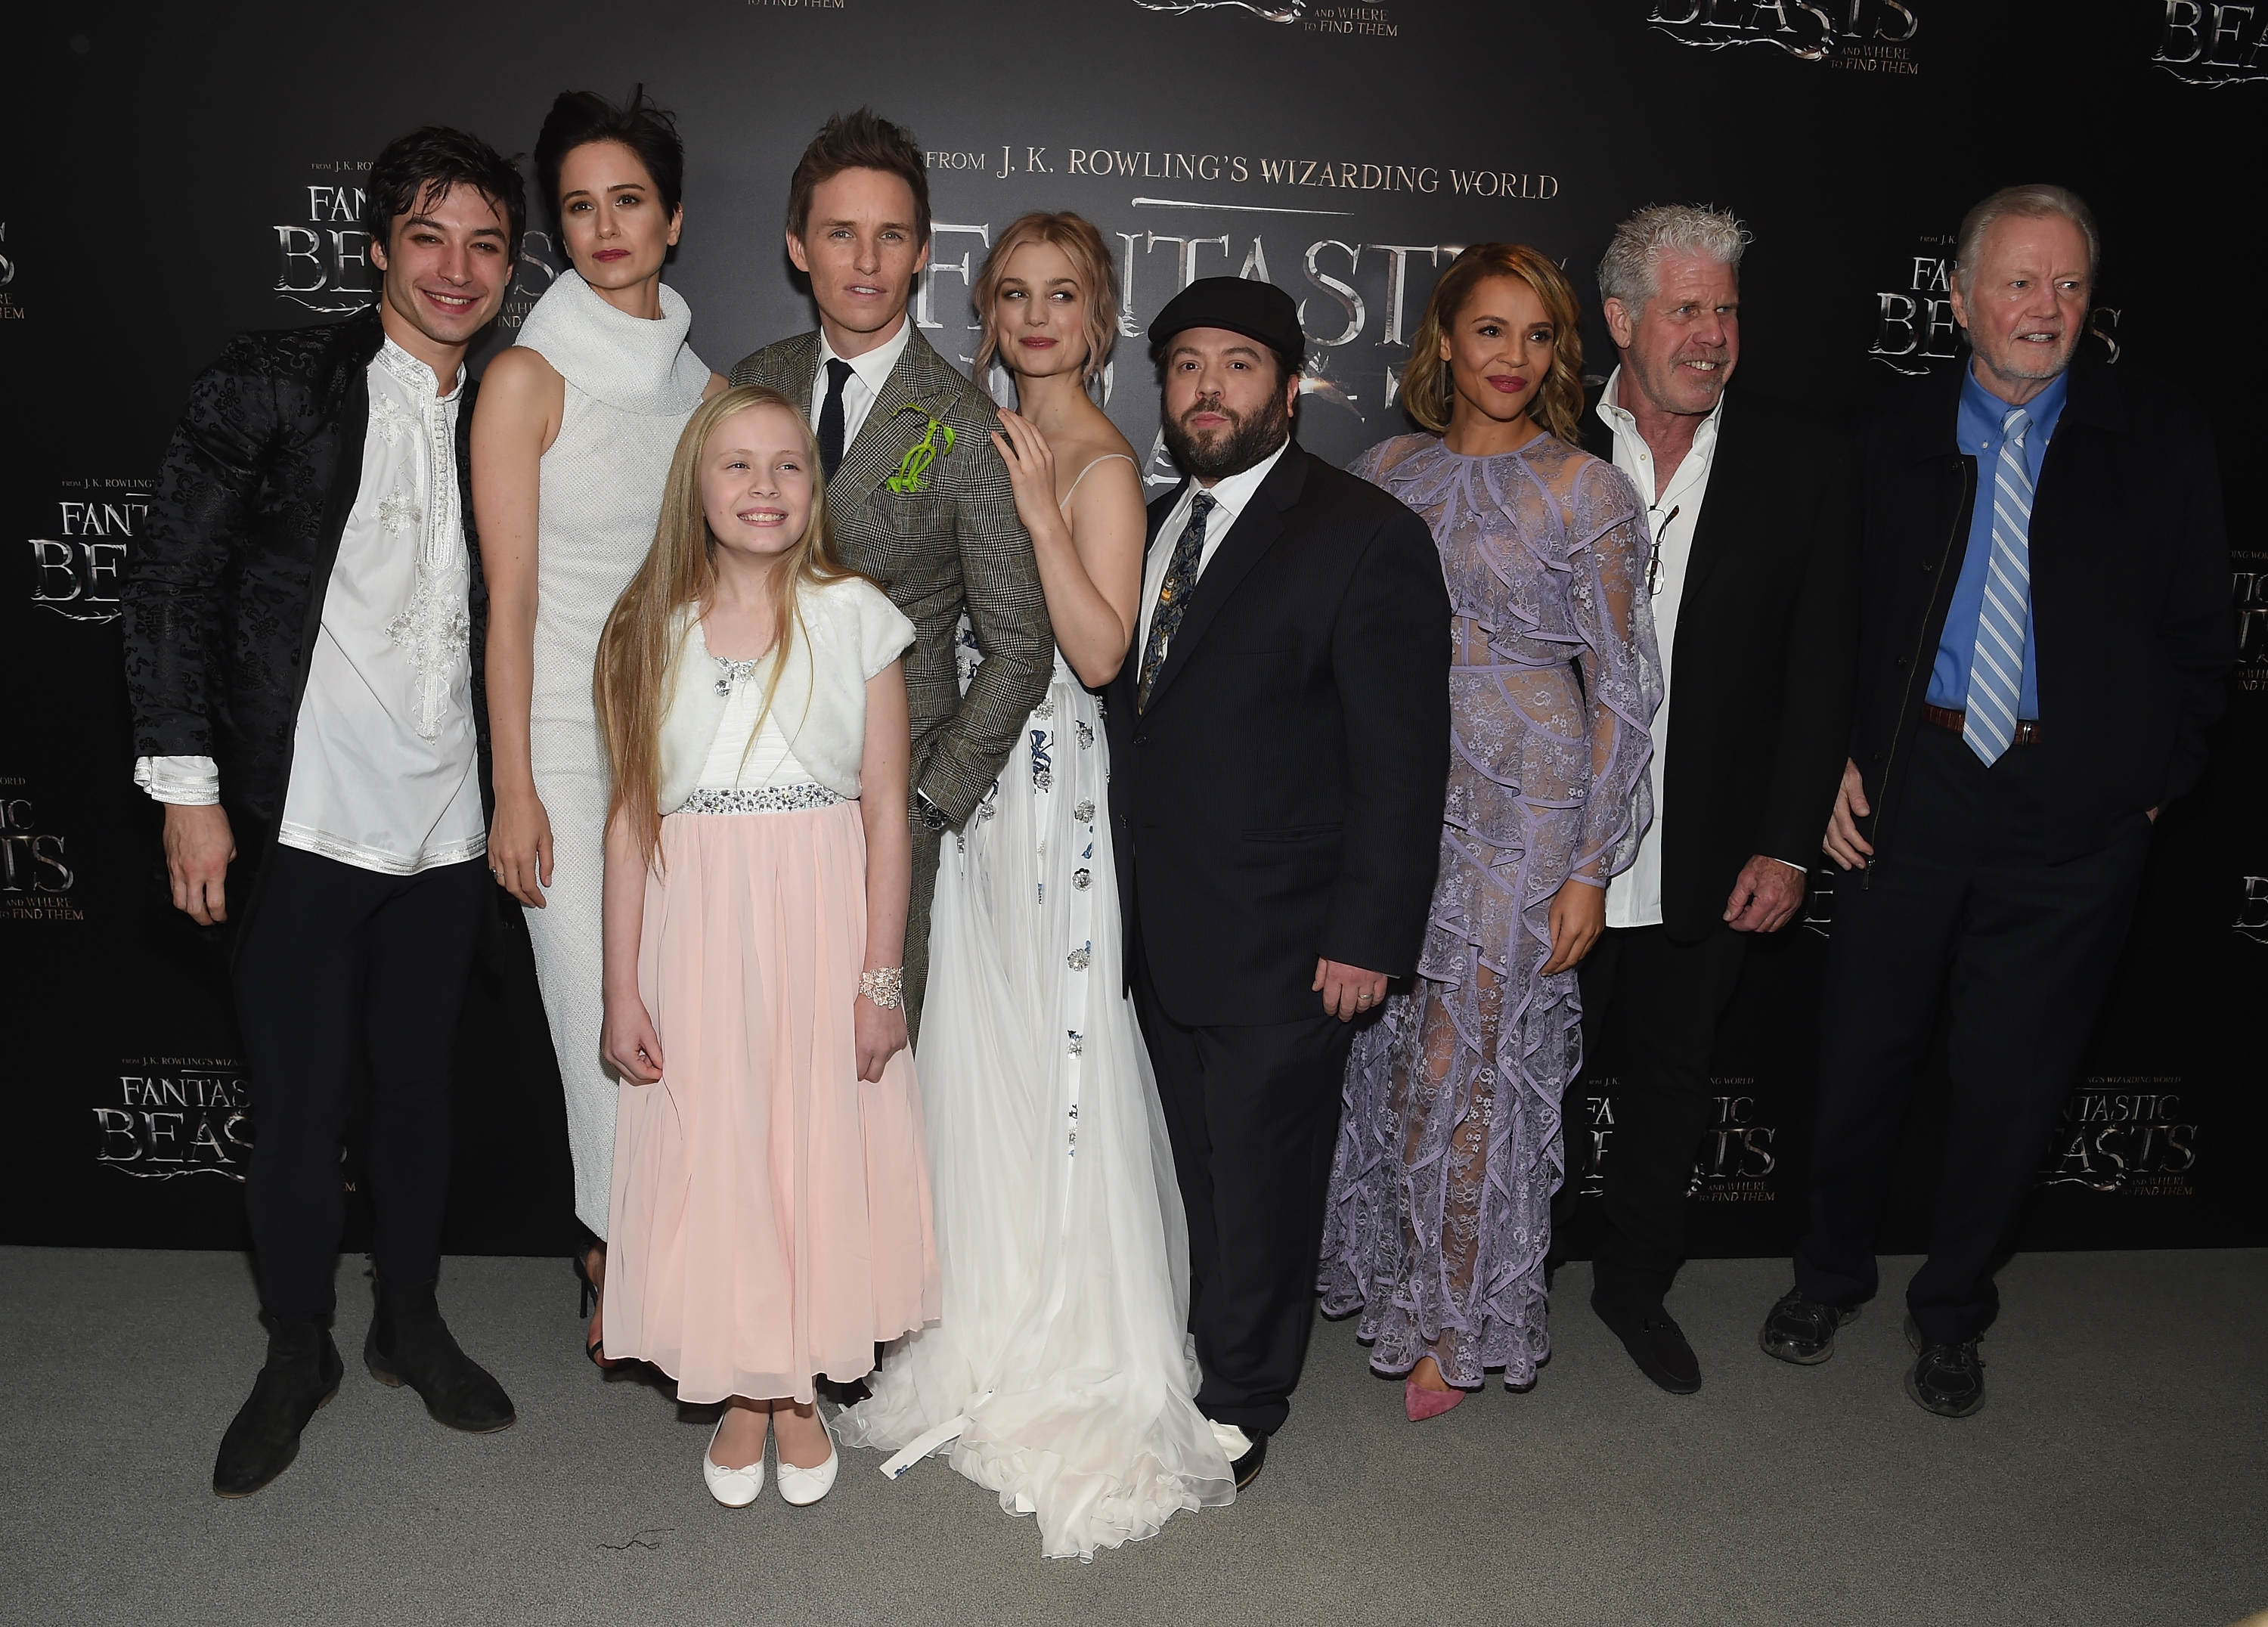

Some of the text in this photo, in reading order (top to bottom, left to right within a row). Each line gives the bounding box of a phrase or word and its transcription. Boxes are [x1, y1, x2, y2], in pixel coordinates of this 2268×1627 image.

[1315, 7, 1390, 22] AND WHERE
[1303, 20, 1399, 37] TO FIND THEM
[1841, 45, 1911, 60] AND WHERE
[1830, 57, 1919, 75] TO FIND THEM
[334, 160, 341, 173] J.
[343, 160, 353, 170] K.
[925, 146, 1559, 200] FROM J. K. ROWLING'S WIZARDING WORLD
[1948, 234, 1957, 244] K.
[84, 478, 91, 490] J.
[92, 479, 102, 488] K.
[105, 479, 155, 488] ROWLING'
[26, 897, 73, 908] WHERE
[12, 908, 43, 920] FIND
[45, 909, 85, 921] THEM
[162, 1057, 214, 1066] ROWLING'S
[1727, 1181, 1768, 1191] WHERE
[2133, 1186, 2160, 1195] FIND
[2162, 1186, 2192, 1195] THEM
[1711, 1192, 1740, 1202] FIND
[1742, 1192, 1776, 1202] THEM
